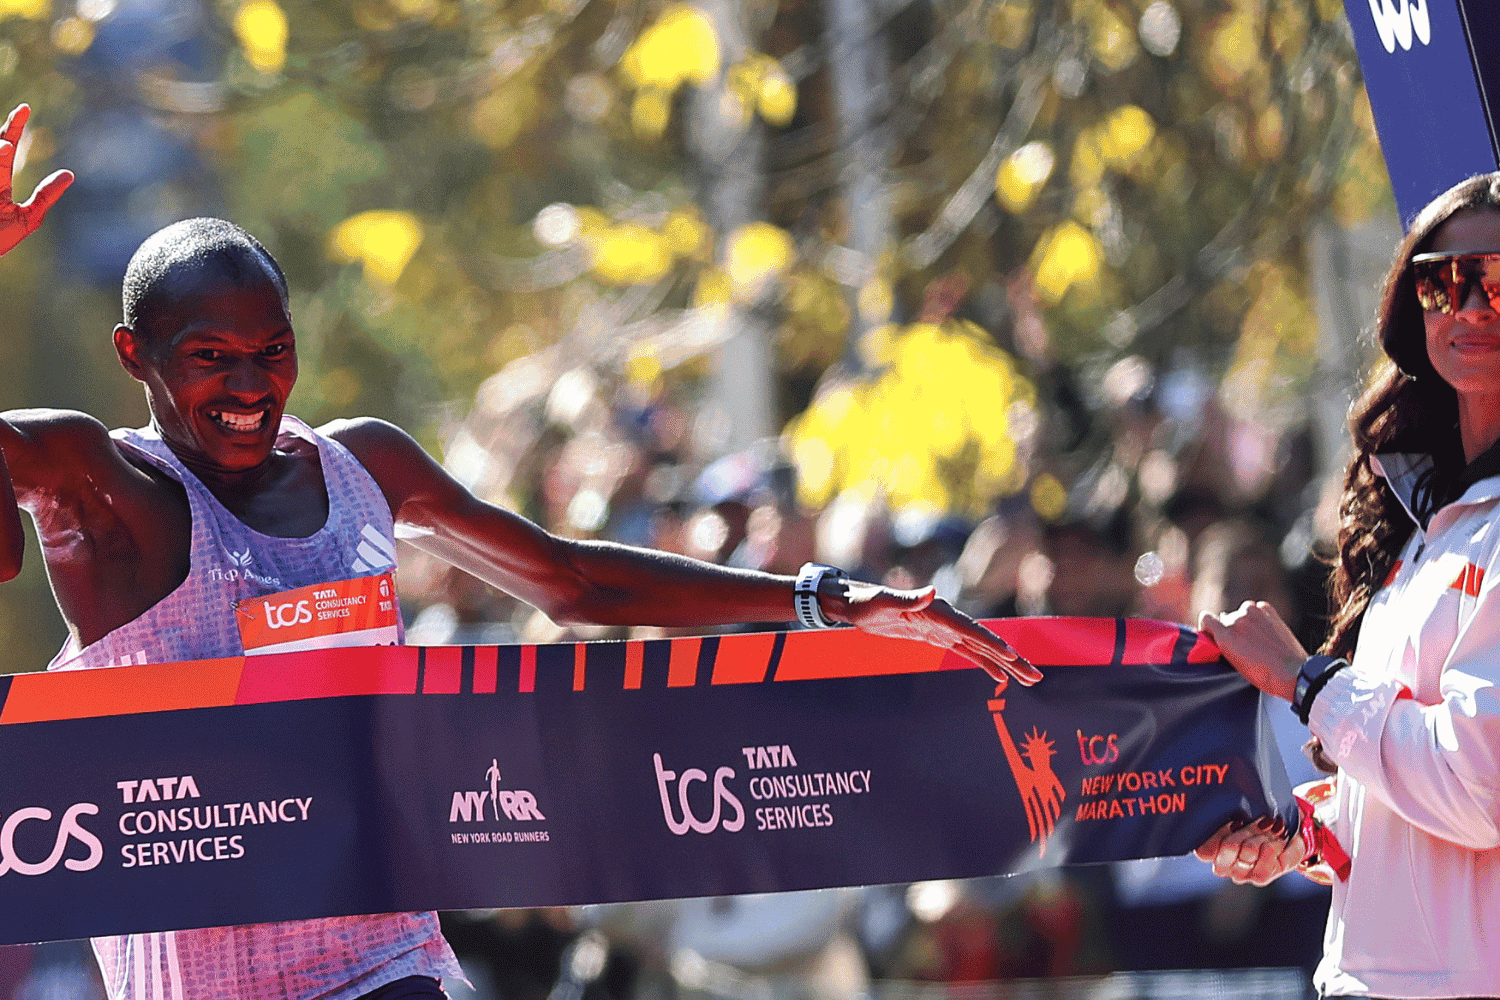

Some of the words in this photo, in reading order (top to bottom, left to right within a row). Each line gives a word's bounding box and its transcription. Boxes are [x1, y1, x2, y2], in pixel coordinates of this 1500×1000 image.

[313, 589, 338, 600] TATA
[315, 595, 367, 611] CONSULTANCY
[317, 608, 351, 622] SERVICES
[742, 744, 798, 770] TATA
[116, 775, 201, 804] TATA
[748, 769, 872, 801] CONSULTANCY
[1081, 775, 1115, 797] NEW
[1115, 768, 1175, 793] YORK
[1179, 763, 1230, 787] CITY
[118, 797, 314, 836] CONSULTANCY
[754, 803, 835, 831] SERVICES
[1074, 793, 1187, 822] MARATHON
[451, 833, 469, 844] NEW
[470, 832, 491, 844] YORK
[491, 832, 513, 843] ROAD
[513, 831, 550, 843] RUNNERS
[121, 835, 246, 869] SERVICES
